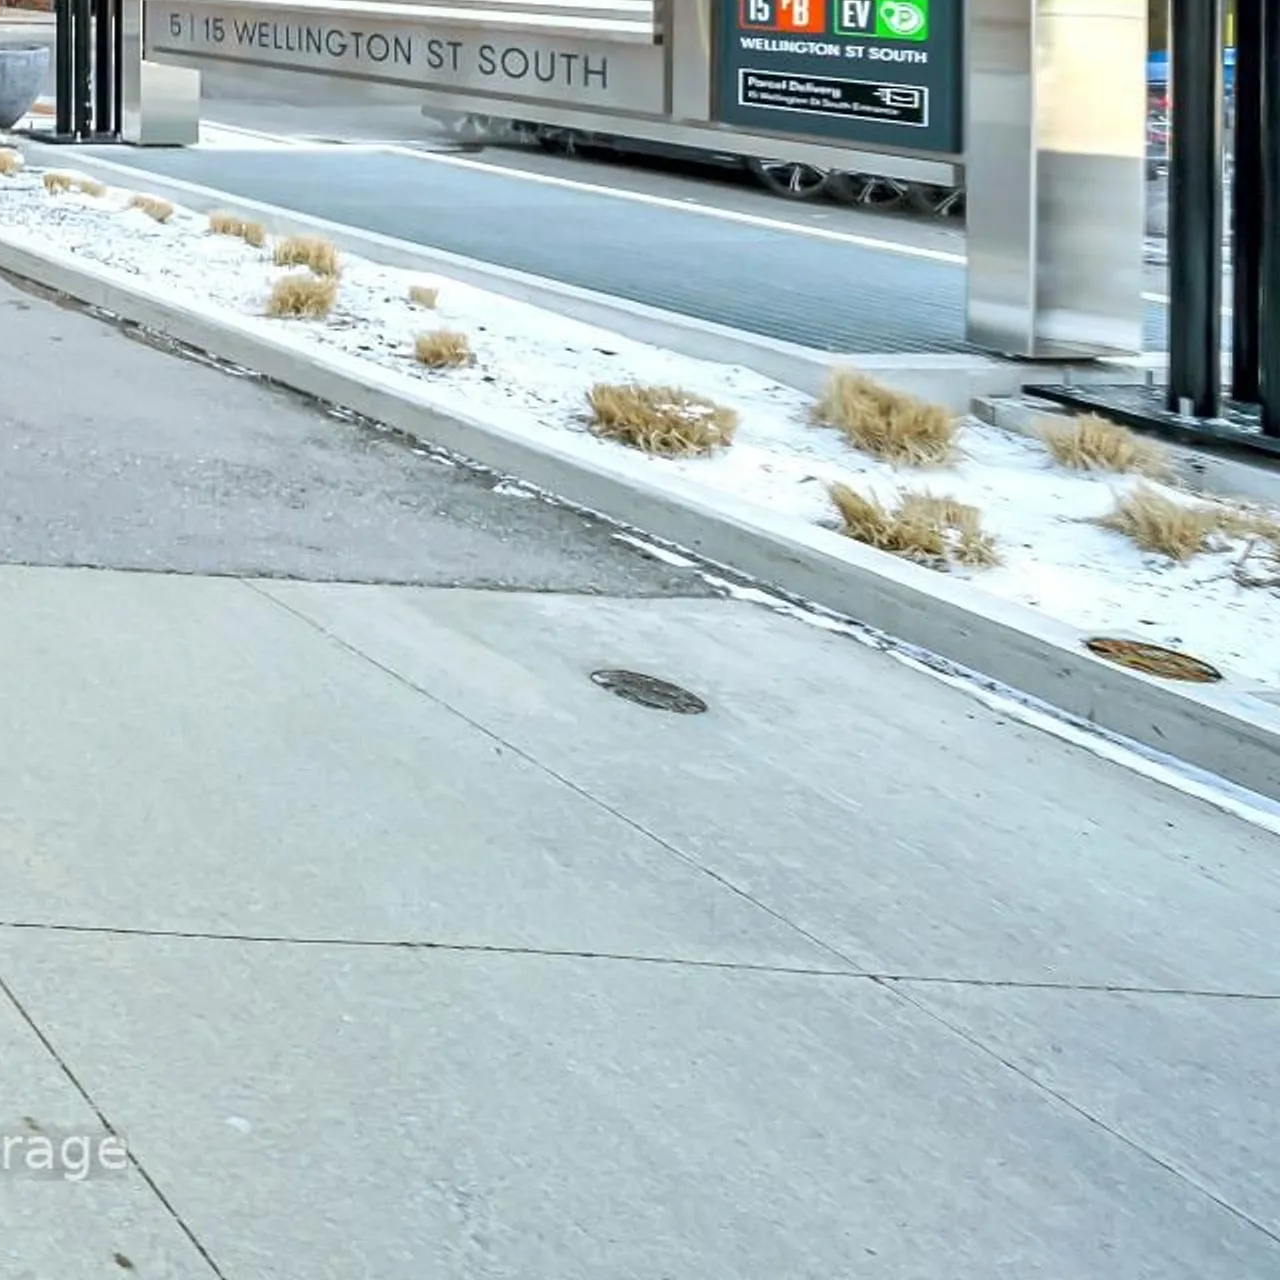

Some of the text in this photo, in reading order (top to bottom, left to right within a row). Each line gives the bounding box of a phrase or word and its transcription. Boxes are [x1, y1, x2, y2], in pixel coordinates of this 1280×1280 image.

[842, 0, 872, 28] EV
[169, 13, 182, 38] 5
[205, 16, 226, 43] 15
[233, 19, 413, 66] WELLINGTON
[426, 41, 464, 72] ST
[477, 45, 609, 90] SOUTH
[739, 36, 929, 64] WELLINGTON ST SOUTH
[788, 79, 843, 100] Delivery
